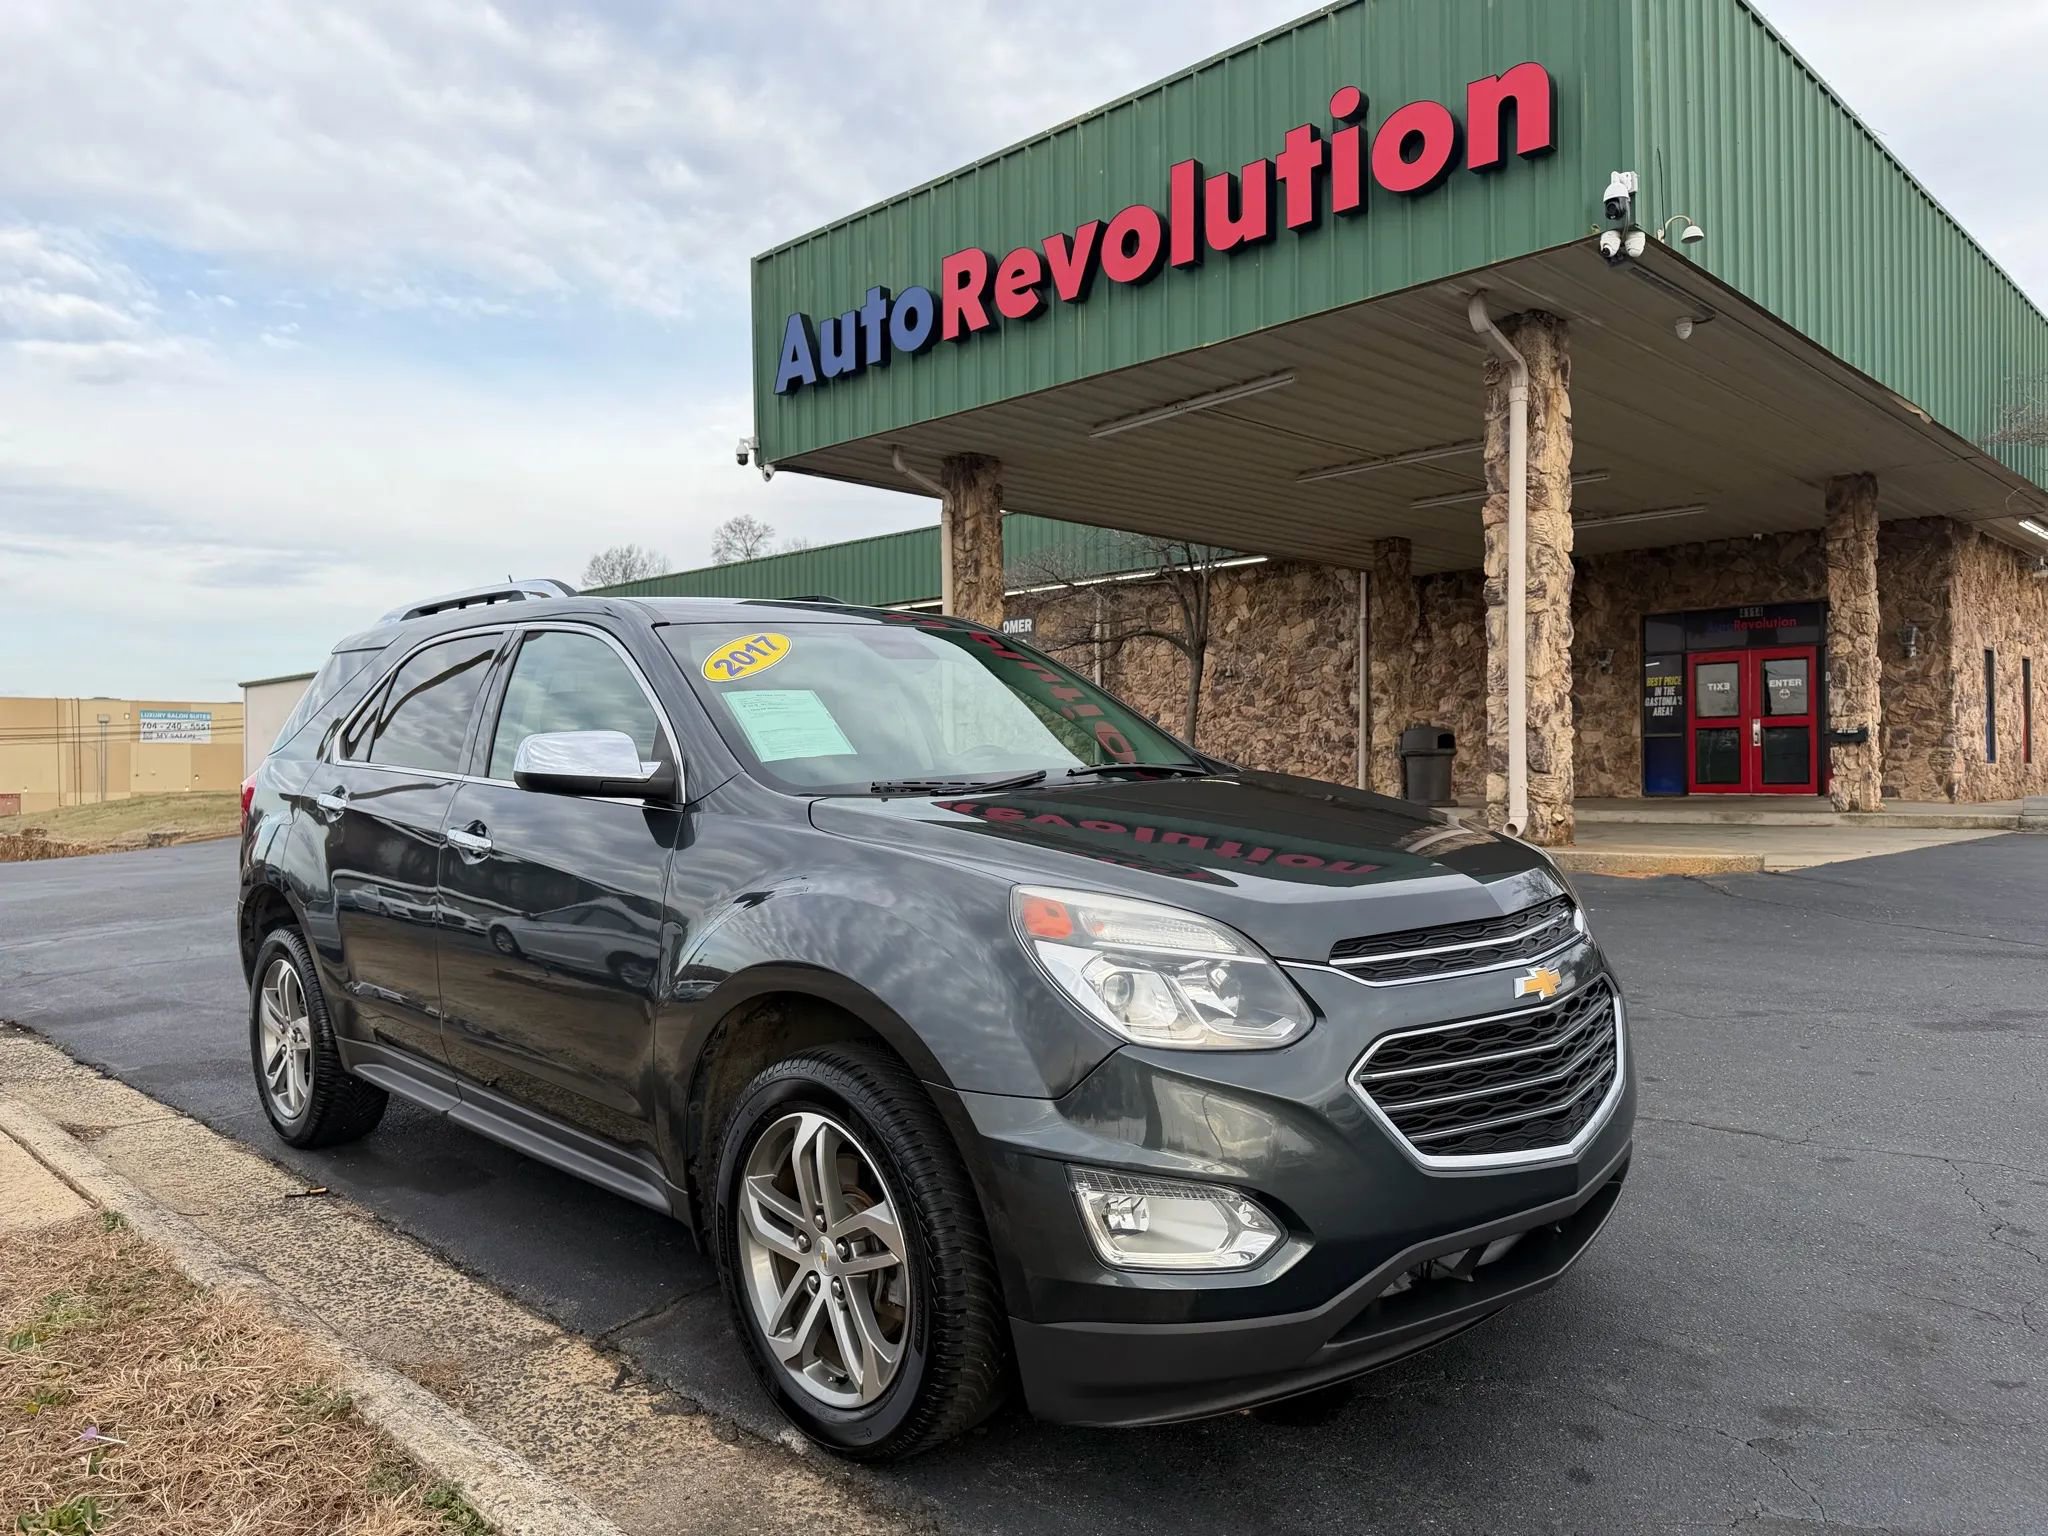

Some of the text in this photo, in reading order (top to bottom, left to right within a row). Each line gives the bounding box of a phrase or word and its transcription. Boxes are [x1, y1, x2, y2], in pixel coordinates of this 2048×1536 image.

[1003, 619, 1032, 633] OMER
[713, 635, 780, 677] 2017
[1646, 677, 1663, 687] BEST
[1768, 679, 1802, 688] ENTER
[1654, 686, 1676, 696] IN THE
[141, 712, 166, 720] LUXURY
[167, 712, 188, 720] SALON
[1652, 706, 1673, 717] AREA!
